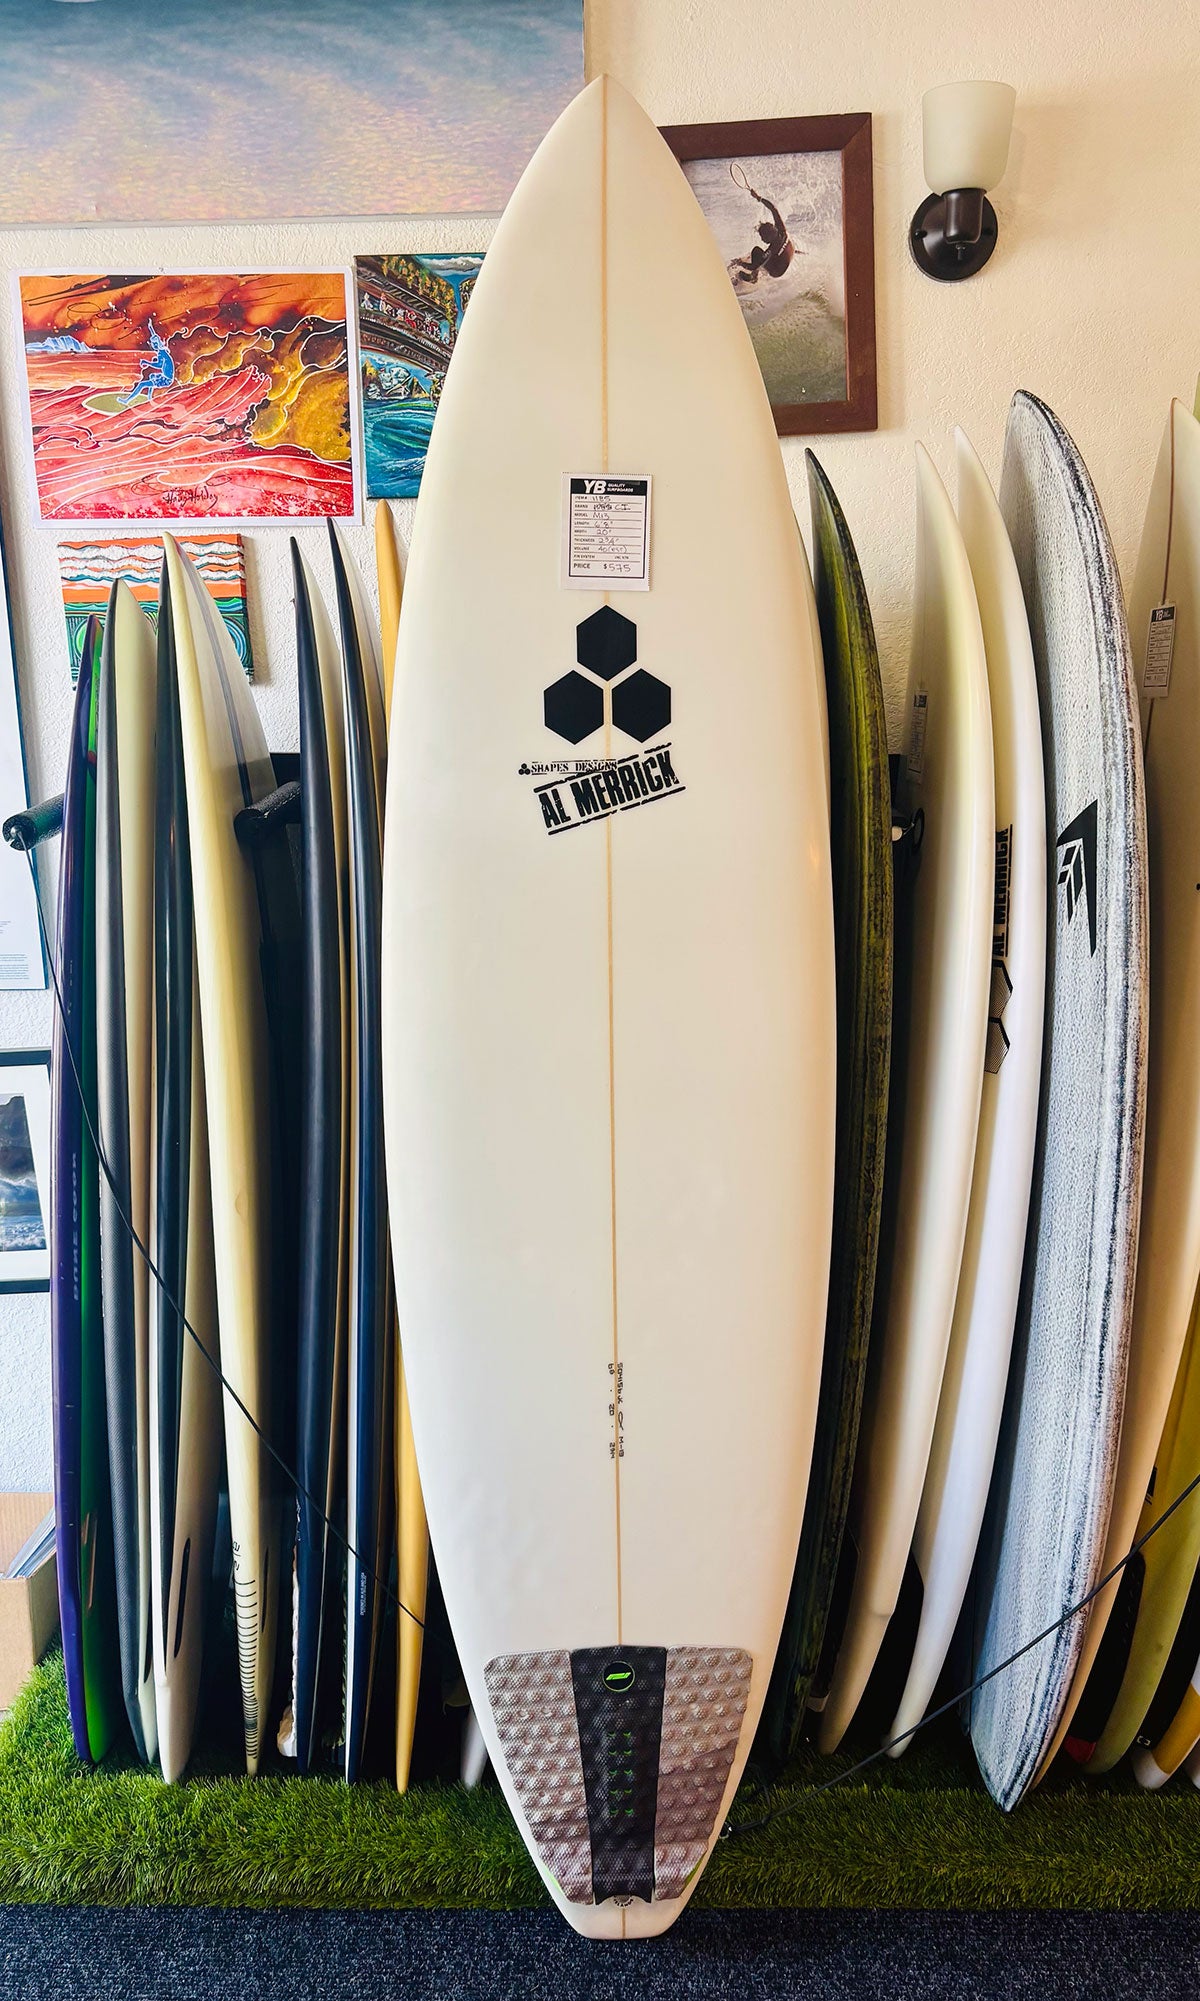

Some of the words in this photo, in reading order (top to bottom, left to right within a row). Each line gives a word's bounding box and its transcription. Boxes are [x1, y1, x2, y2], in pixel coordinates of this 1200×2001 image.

[584, 480, 606, 494] YB
[531, 763, 569, 773] SHAPES
[575, 761, 618, 772] DESIGNS
[538, 788, 571, 829] AL
[569, 750, 680, 818] MERRICK
